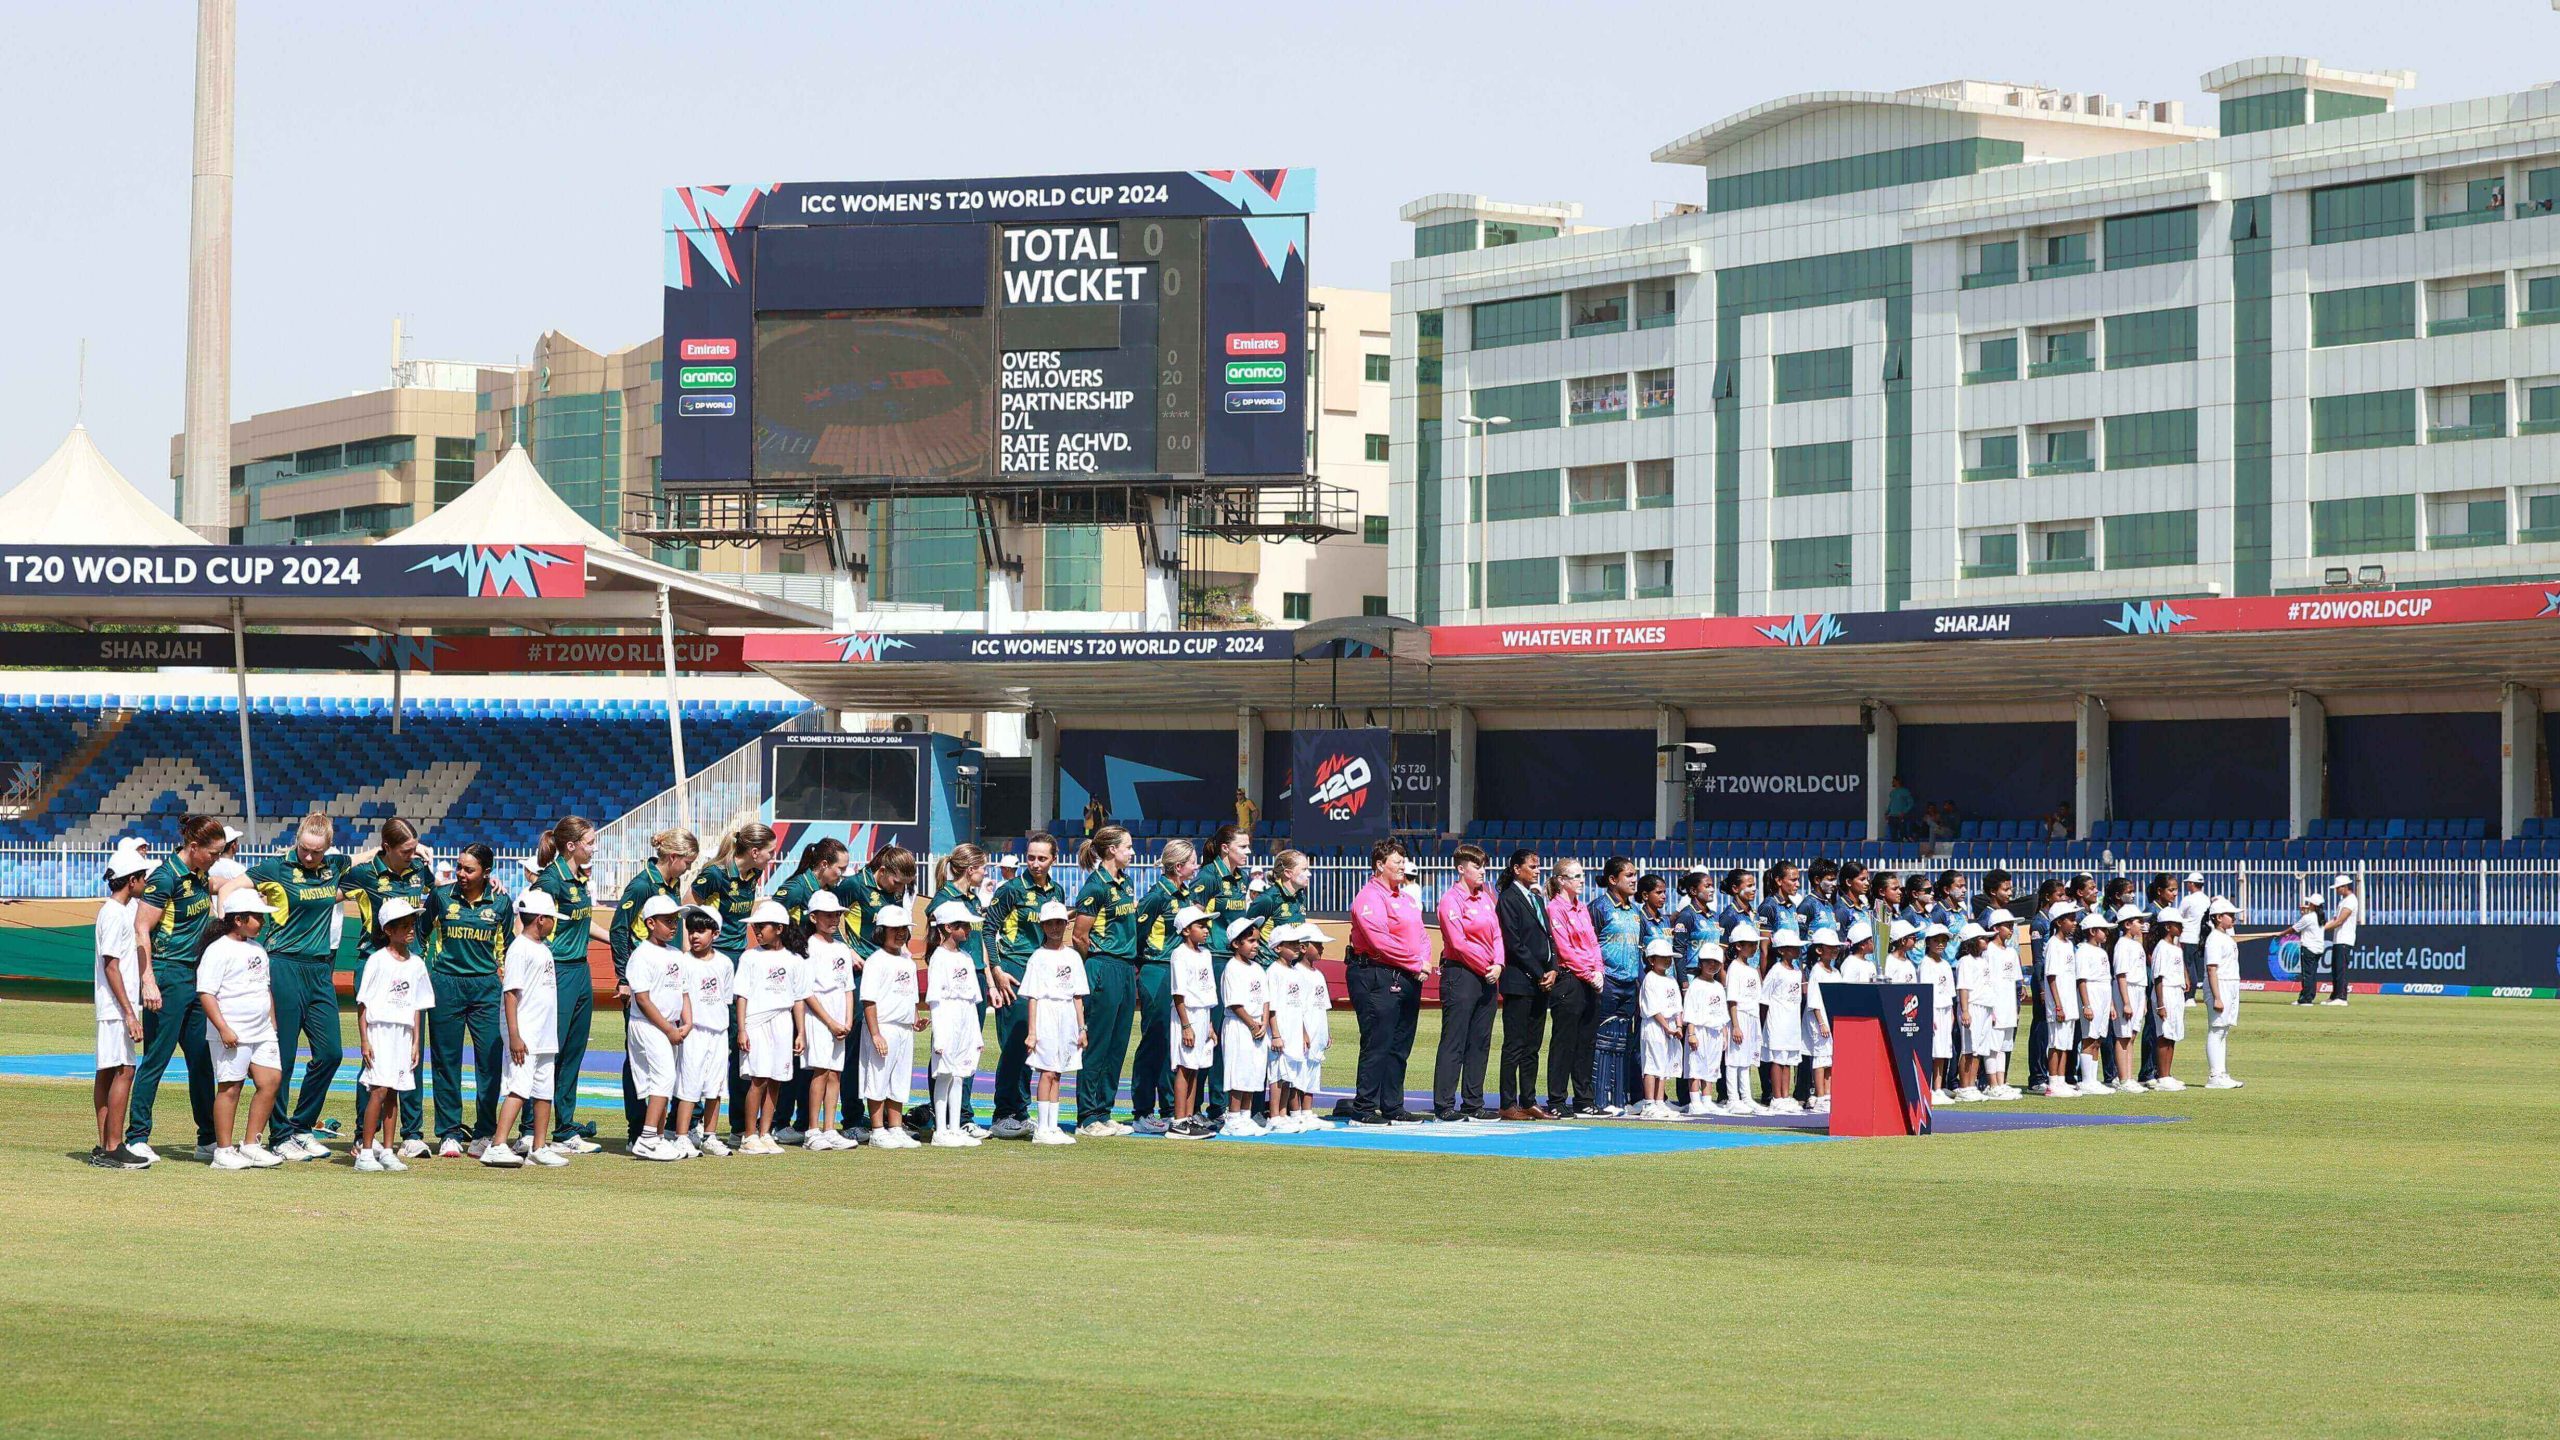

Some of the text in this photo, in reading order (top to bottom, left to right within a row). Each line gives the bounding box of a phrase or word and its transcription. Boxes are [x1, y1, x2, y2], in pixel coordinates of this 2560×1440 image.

[801, 185, 1169, 213] ICC WOMEN'S T20 WORLD CUP 2024
[1004, 227, 1118, 262] TOTAL
[1144, 224, 1164, 256] 0
[1003, 267, 1147, 303] WICKET
[1163, 268, 1180, 296] 0
[687, 344, 730, 355] Emirates
[1233, 338, 1279, 350] Emirates
[1002, 351, 1061, 370] OVERS
[1167, 350, 1178, 366] 0
[683, 372, 733, 383] aramco
[1002, 369, 1103, 389] REM.OVERS
[1162, 370, 1182, 386] 20
[1229, 367, 1283, 378] aramco
[1001, 391, 1134, 411] PARTNERSHIP
[1166, 393, 1177, 408] 0
[1254, 398, 1283, 406] WORLD
[1001, 412, 1034, 430] D/L
[1001, 433, 1132, 453] RATE ACHVD.
[1167, 436, 1191, 450] 0.0
[1001, 453, 1099, 473] RATE REQ.
[4, 556, 361, 585] T20 WORLD CUP 2024
[2288, 598, 2432, 620] #T20WORLDCUP
[1934, 614, 2011, 633] SHARJAH
[972, 637, 1264, 655] ICC WOMEN'S T20 WORLD CUP 2024
[1502, 627, 1666, 647] WHATEVER IT TAKES
[100, 640, 202, 660] SHARJAH
[1408, 764, 1426, 773] T20
[1705, 775, 1860, 793] #T20WORLDCUP
[1330, 808, 1350, 820] ICC
[447, 926, 492, 941] AUSTRALIA
[2406, 947, 2418, 969] 4
[2420, 946, 2466, 970] Good
[2403, 983, 2444, 994] aramco
[2492, 987, 2533, 997] aramco
